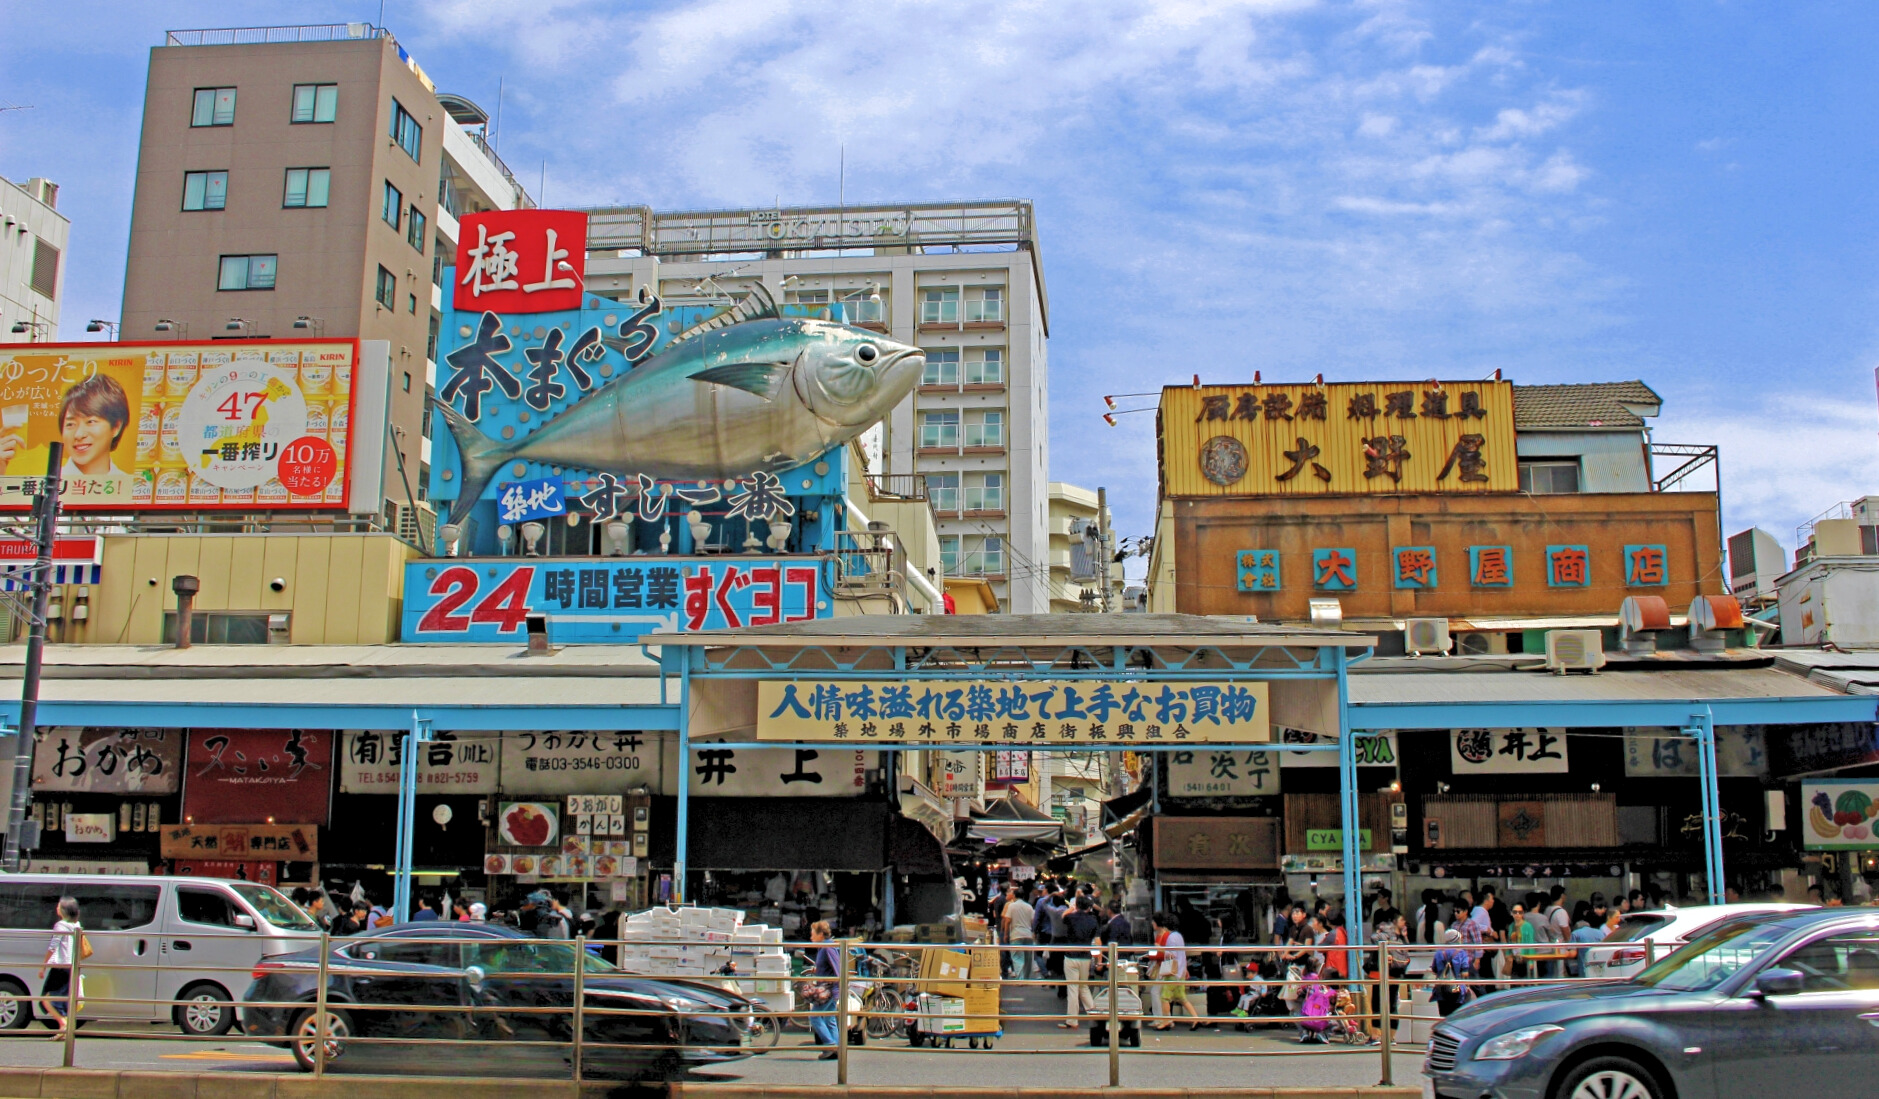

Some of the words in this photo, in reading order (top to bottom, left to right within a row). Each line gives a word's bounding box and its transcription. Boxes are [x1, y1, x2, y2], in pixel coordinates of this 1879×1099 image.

[461, 224, 576, 298] 極上
[0, 357, 98, 385] ゆったり
[320, 353, 346, 361] KIRIN
[440, 287, 663, 421] 本まぐろ
[0, 386, 62, 401] 心が広い。
[216, 391, 270, 420] 47
[202, 442, 278, 462] 一番搾り
[285, 445, 332, 465] 10万
[1275, 434, 1490, 483] 大野屋
[292, 465, 322, 475] 名様に
[500, 482, 563, 521] 築地
[580, 471, 796, 524] すし一番
[1317, 546, 1665, 586] 大野屋商店
[769, 684, 1257, 725] 人情味溢れる築地で上手なお買物
[833, 722, 1192, 740] 築地場外市場商店街振興組合
[51, 738, 163, 777] おかめ
[695, 738, 823, 785] 井上
[1311, 833, 1336, 844] CYA
